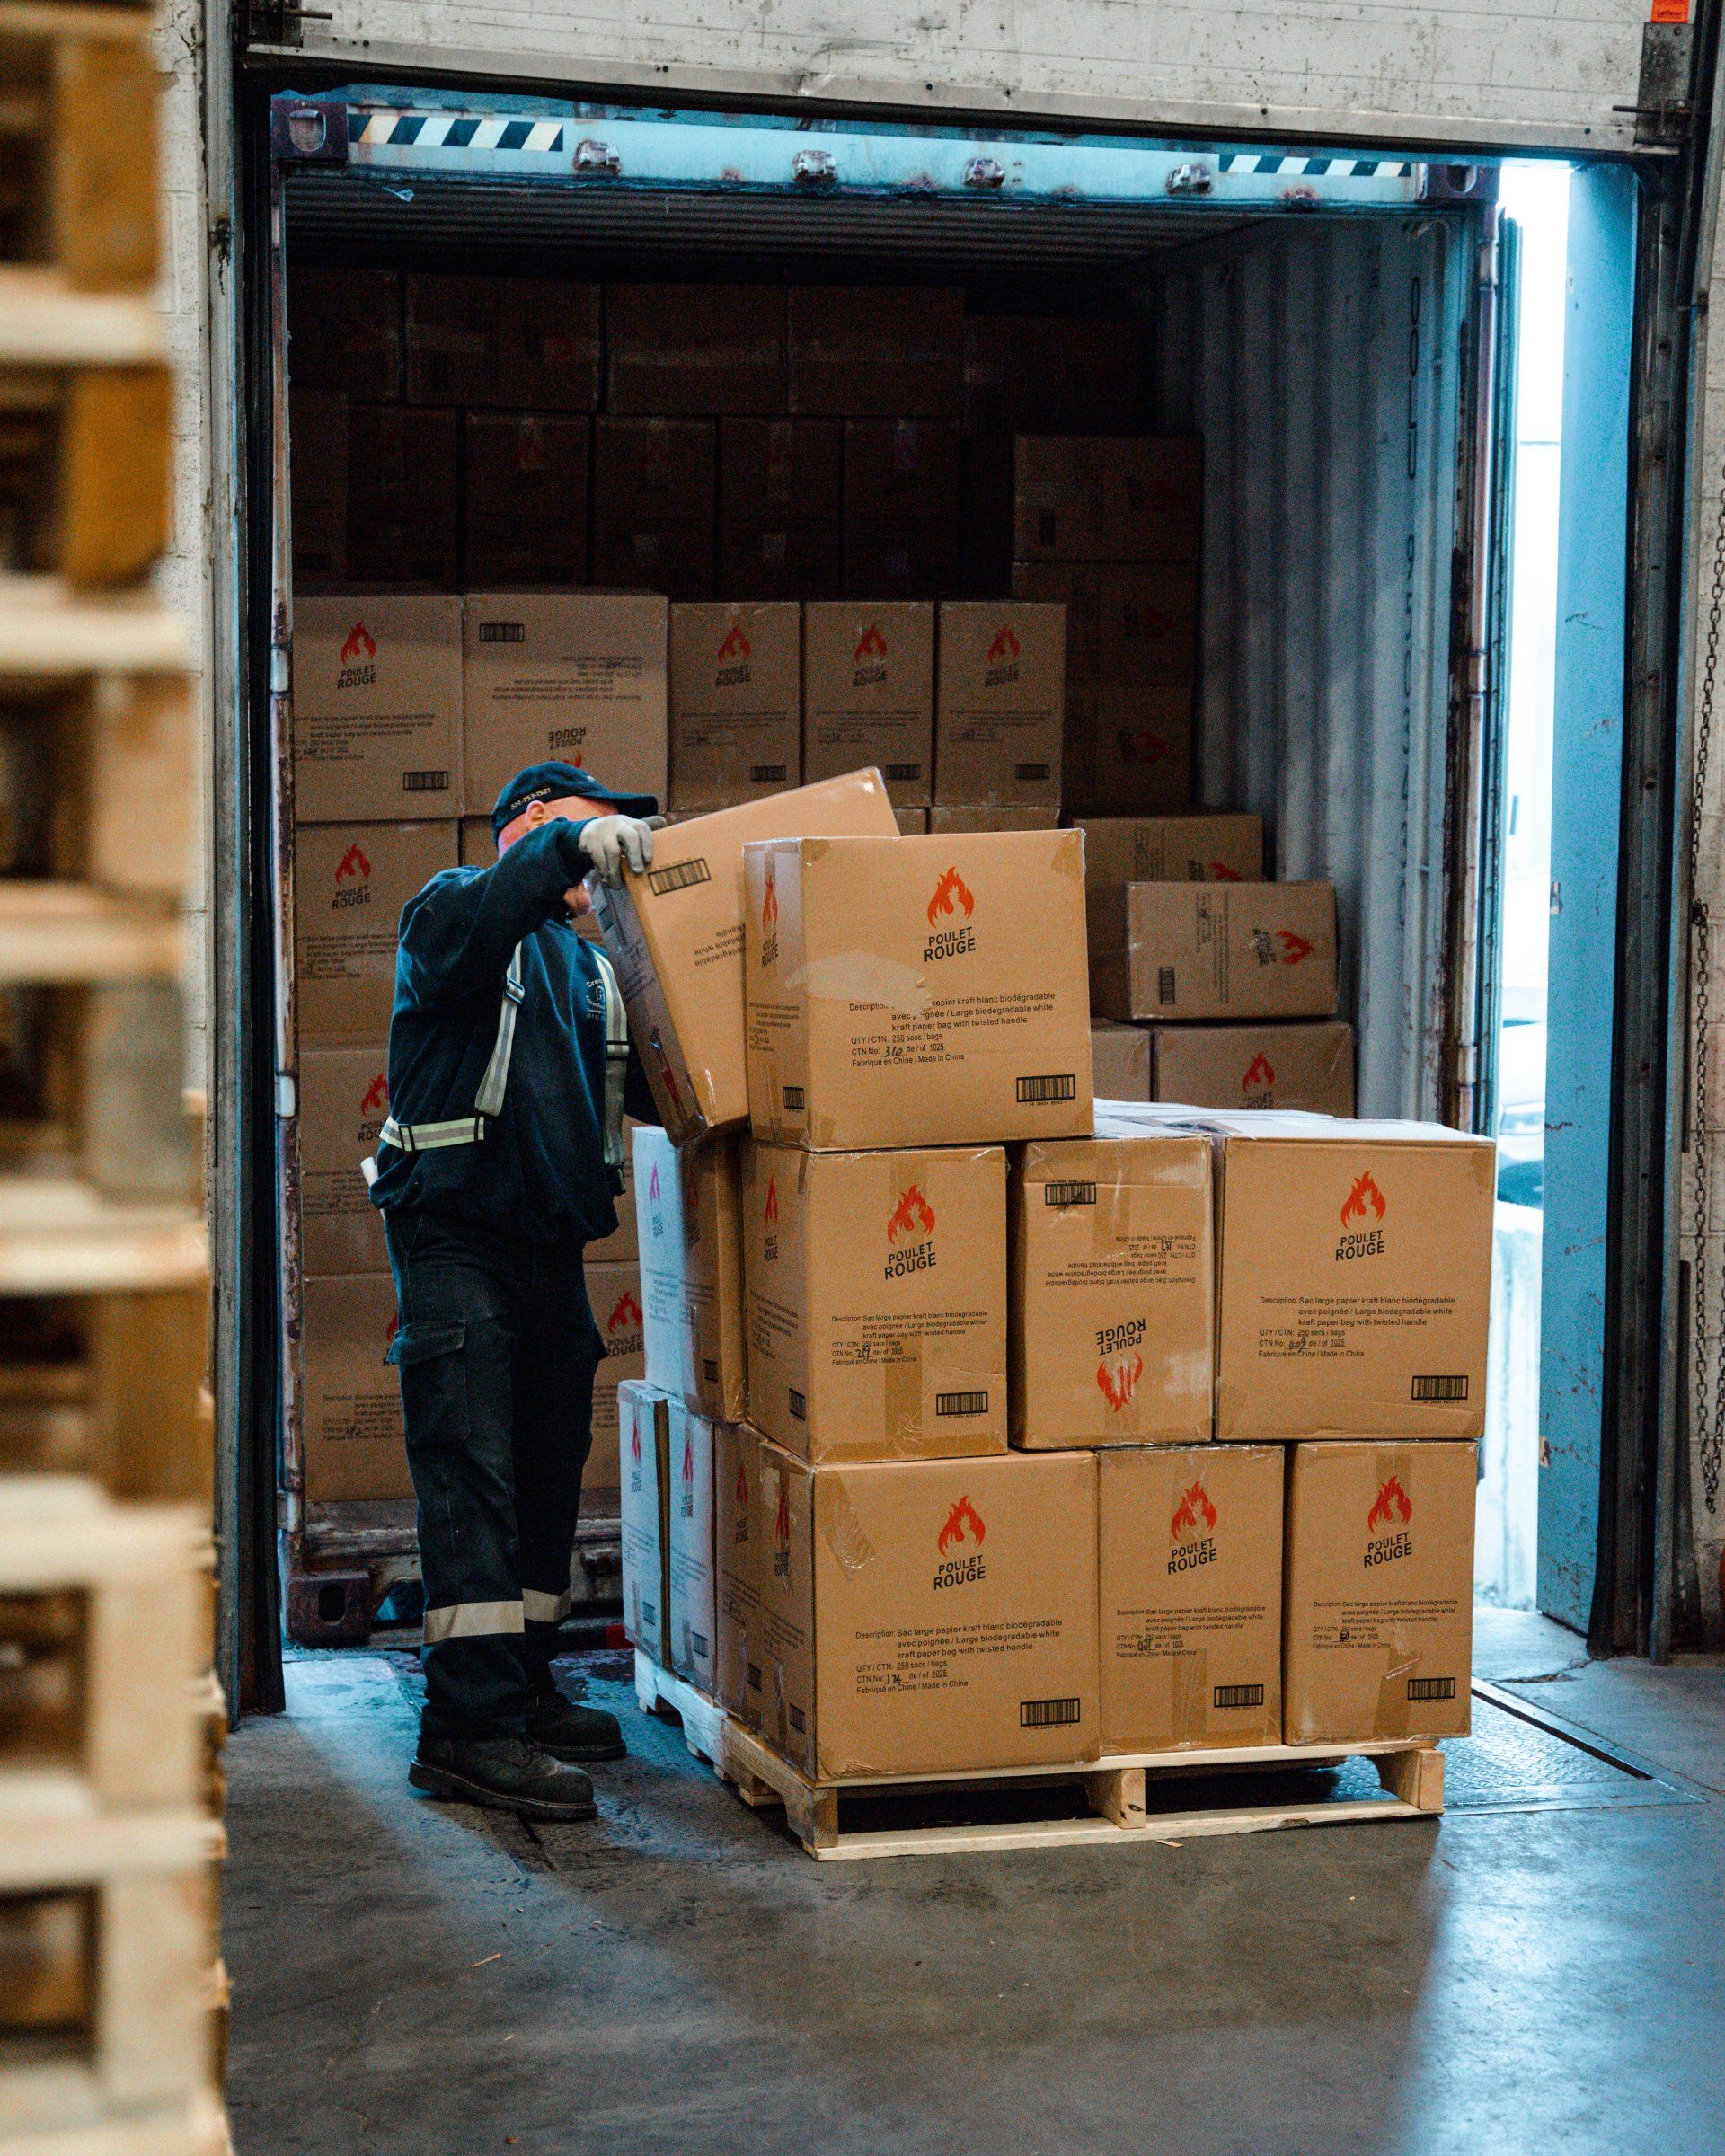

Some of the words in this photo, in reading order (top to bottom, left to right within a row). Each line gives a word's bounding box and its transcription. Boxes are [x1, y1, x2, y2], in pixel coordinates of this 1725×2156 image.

[337, 674, 376, 690] ROUGE
[548, 726, 586, 741] ROUGE
[332, 893, 370, 910] ROUGE
[928, 926, 973, 946] POULET
[694, 945, 713, 956] white
[924, 937, 976, 962] ROUGE
[958, 996, 975, 1004] kraft
[978, 995, 997, 1003] blanc
[1000, 992, 1055, 1003] biodégradable
[951, 1008, 973, 1018] Large
[976, 1004, 1031, 1016] biodegradable
[1033, 1003, 1053, 1012] white
[892, 1023, 910, 1031] kraft
[913, 1023, 934, 1031] paper
[937, 1021, 951, 1029] bag
[954, 1020, 969, 1028] with
[971, 1018, 999, 1026] twisted
[1002, 1016, 1027, 1025] handle
[871, 1035, 889, 1043] CTN:
[892, 1034, 905, 1042] 250
[927, 1032, 942, 1042] bags
[920, 1045, 926, 1053] of
[931, 1044, 944, 1052] 1025
[853, 1058, 881, 1068] Fabriqué
[894, 1056, 913, 1065] Chine
[919, 1055, 936, 1063] Made
[945, 1054, 964, 1062] China
[1340, 1230, 1383, 1247] POULET
[889, 1241, 933, 1265] POULET
[1335, 1240, 1385, 1261] ROUGE
[884, 1252, 936, 1279] ROUGE
[1314, 1296, 1333, 1305] large
[1336, 1296, 1359, 1305] papier
[1402, 1296, 1455, 1305] biodégradable
[1318, 1308, 1348, 1316] poignée
[1354, 1307, 1376, 1316] Large
[1377, 1307, 1430, 1316] biodegradable
[1340, 1318, 1354, 1327] bag
[1096, 1319, 1146, 1345] ROUGE
[1259, 1329, 1272, 1337] QTY
[1330, 1329, 1345, 1338] bags
[1100, 1333, 1142, 1355] POULET
[1172, 1538, 1213, 1560] POULET
[1367, 1533, 1409, 1552] POULET
[1168, 1549, 1216, 1574] ROUGE
[1364, 1542, 1412, 1568] ROUGE
[938, 1555, 983, 1575] POULET
[933, 1566, 986, 1590] ROUGE
[898, 1628, 912, 1636] Sac
[914, 1627, 934, 1637] large
[936, 1625, 960, 1635] papier
[963, 1623, 981, 1631] kraft
[983, 1621, 1004, 1630] blanc
[1006, 1618, 1062, 1630] biodégradable
[918, 1637, 950, 1648] poignée
[956, 1635, 978, 1645] Large
[981, 1631, 1037, 1643] biodegradable
[1039, 1630, 1059, 1638] white
[898, 1650, 915, 1658] kraft
[917, 1650, 940, 1658] paper
[942, 1648, 956, 1657] bag
[959, 1647, 974, 1655] with
[977, 1645, 1004, 1653] twisted
[1007, 1643, 1032, 1651] handle
[857, 1665, 871, 1673] QTY
[898, 1662, 909, 1670] 250
[932, 1659, 947, 1669] bags
[857, 1675, 871, 1683] CTN
[857, 1685, 886, 1696] Fabriqué
[898, 1683, 916, 1692] Chine
[922, 1682, 940, 1690] Made
[949, 1680, 968, 1688] China
